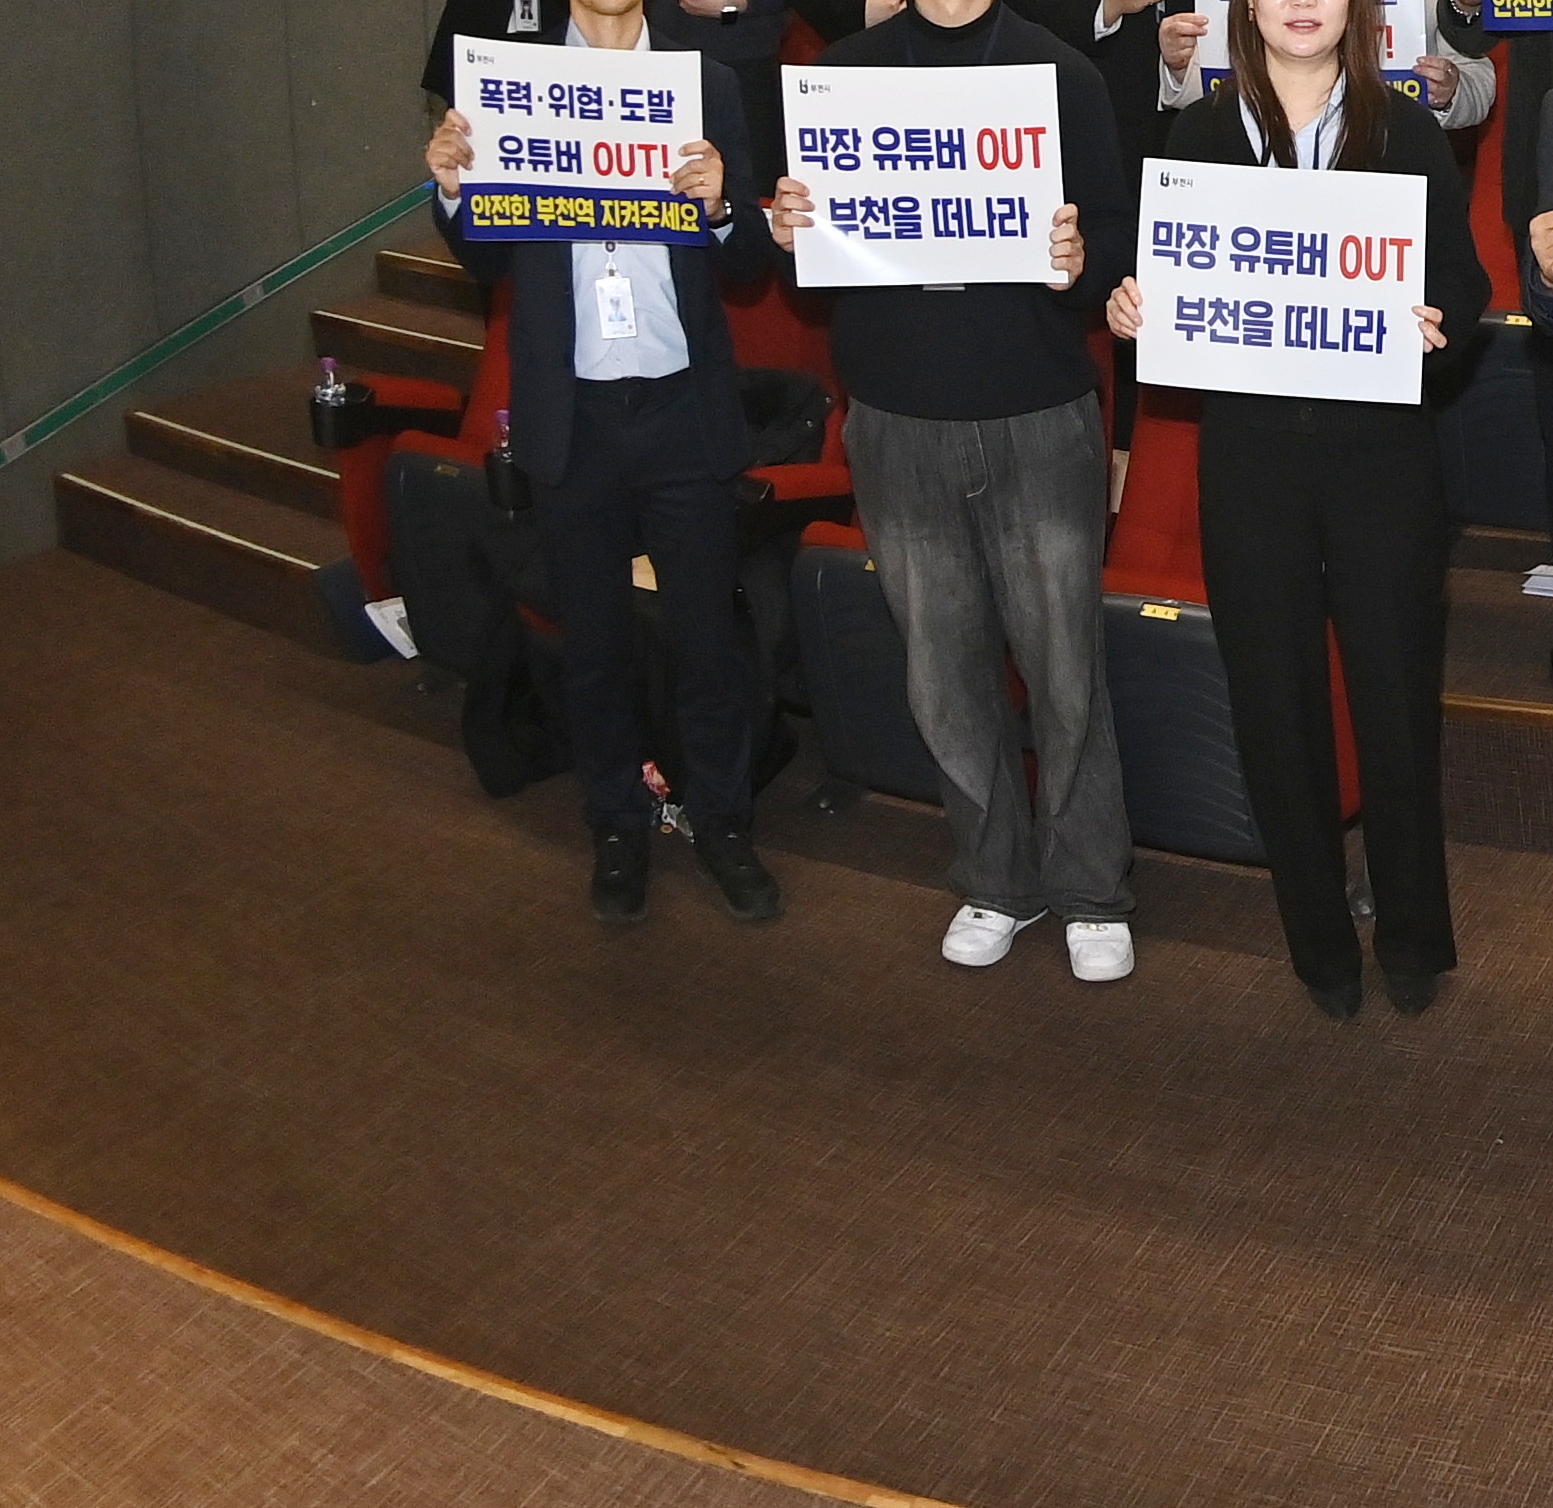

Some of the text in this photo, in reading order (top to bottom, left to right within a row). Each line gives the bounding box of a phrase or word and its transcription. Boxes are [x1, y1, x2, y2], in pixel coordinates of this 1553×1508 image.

[480, 78, 674, 123] 폭력·위협·도발
[499, 136, 671, 179] 유튜버 OUT!
[799, 127, 1046, 171] 막장 유튜버 OUT
[1173, 178, 1193, 187] 부천시
[471, 195, 699, 232] 안전한 부천역 지켜주세요
[830, 196, 1029, 239] 부천을 떠나라
[1153, 221, 1412, 281] 막장 유튜버 OUT
[1175, 296, 1387, 354] 부천을 떠나라
